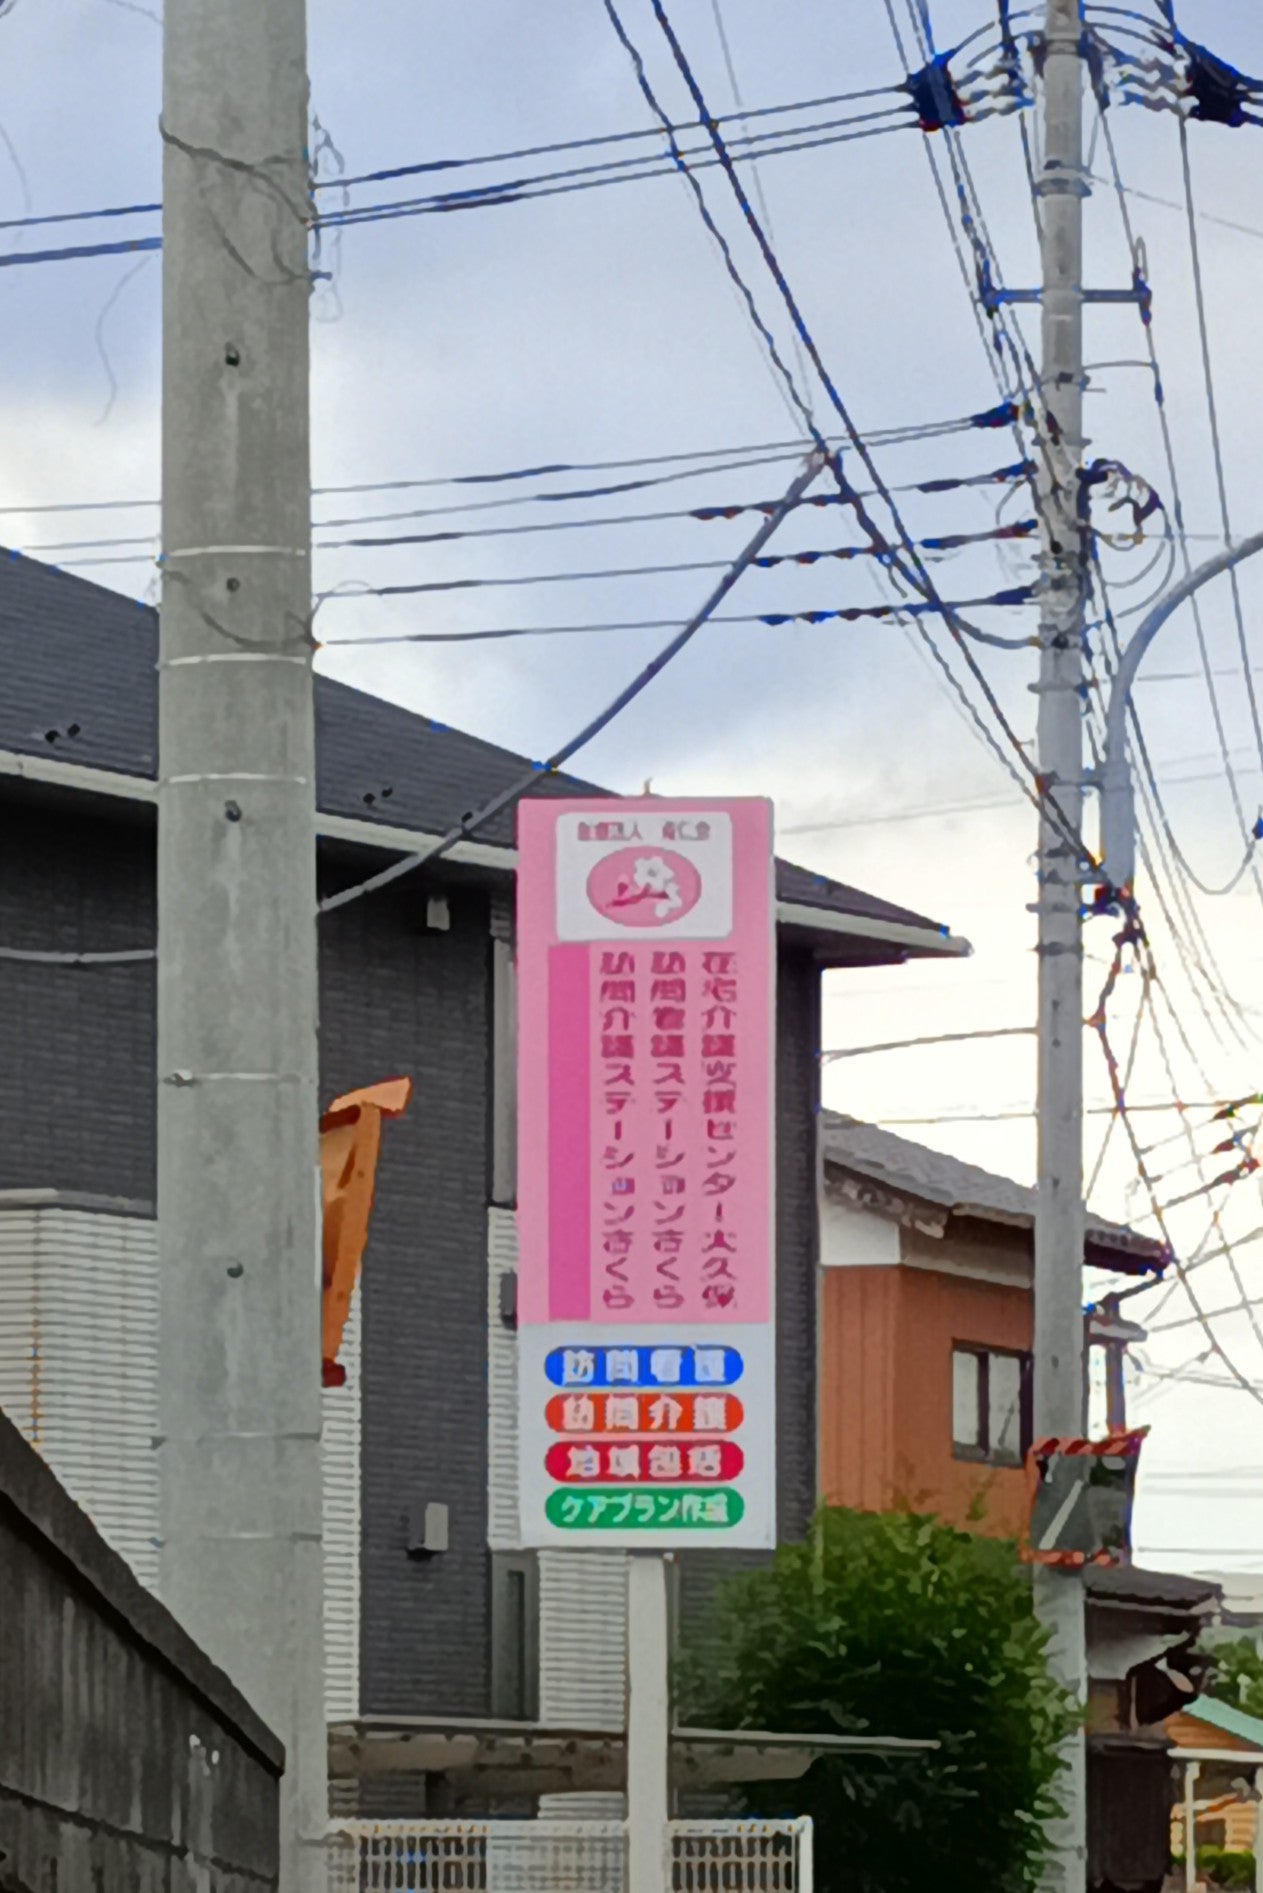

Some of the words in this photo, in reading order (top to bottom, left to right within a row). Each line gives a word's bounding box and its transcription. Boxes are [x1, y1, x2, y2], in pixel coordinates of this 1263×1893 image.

[562, 1348, 726, 1383] 訪問
[562, 1394, 727, 1430] 訪問介
